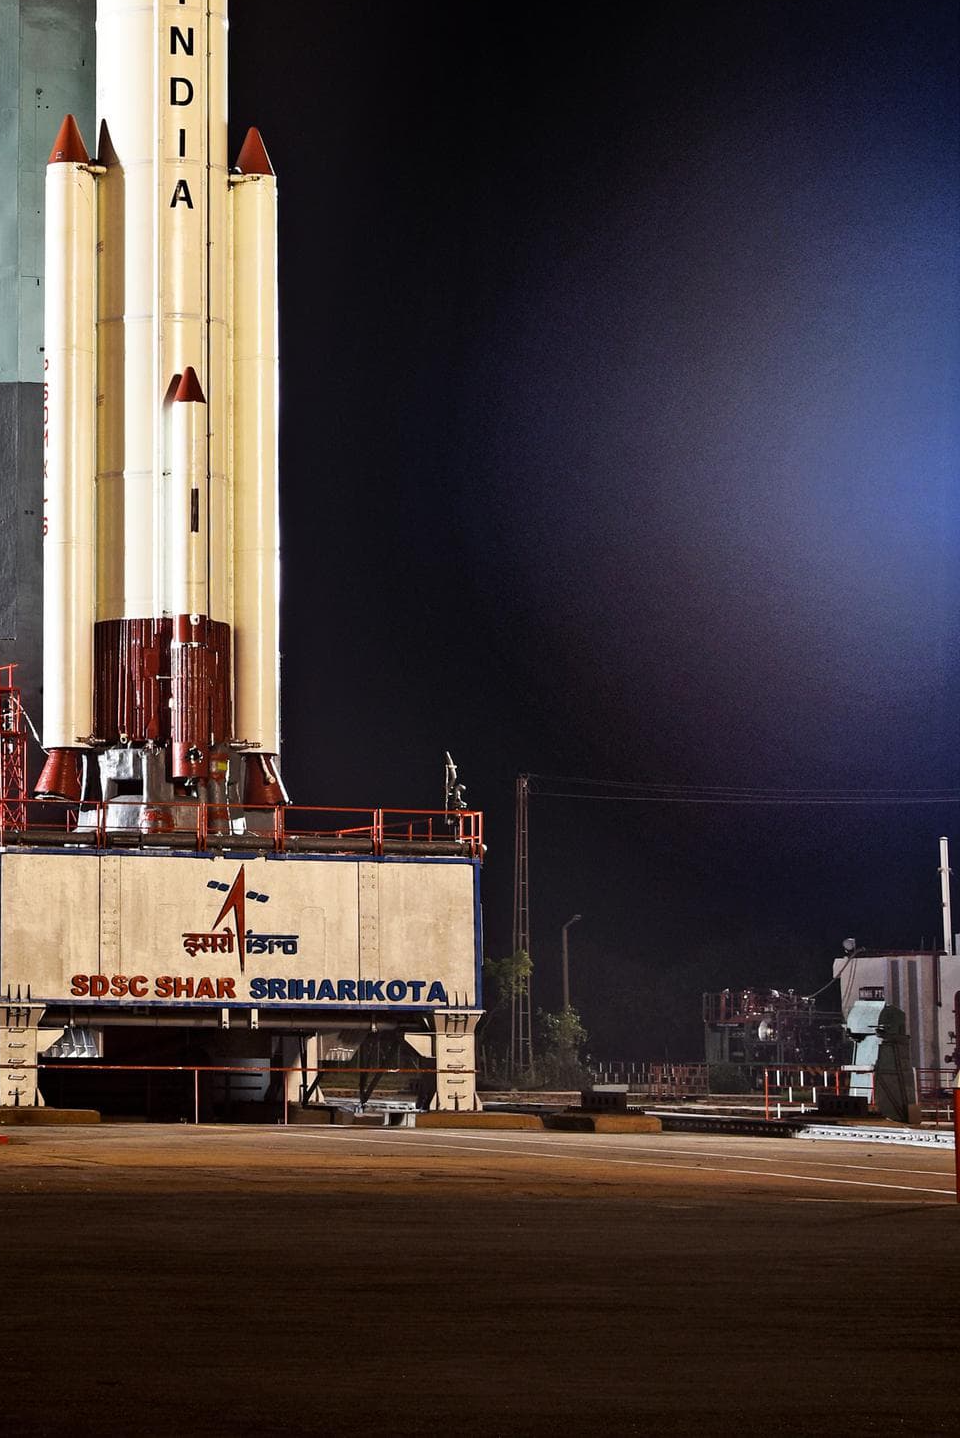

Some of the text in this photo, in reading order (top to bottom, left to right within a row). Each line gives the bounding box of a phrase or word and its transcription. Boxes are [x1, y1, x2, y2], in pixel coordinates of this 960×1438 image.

[181, 926, 236, 957] इसरो
[244, 928, 299, 956] isro
[70, 973, 448, 1004] SDSC SHAR SRIHARIKOTA
